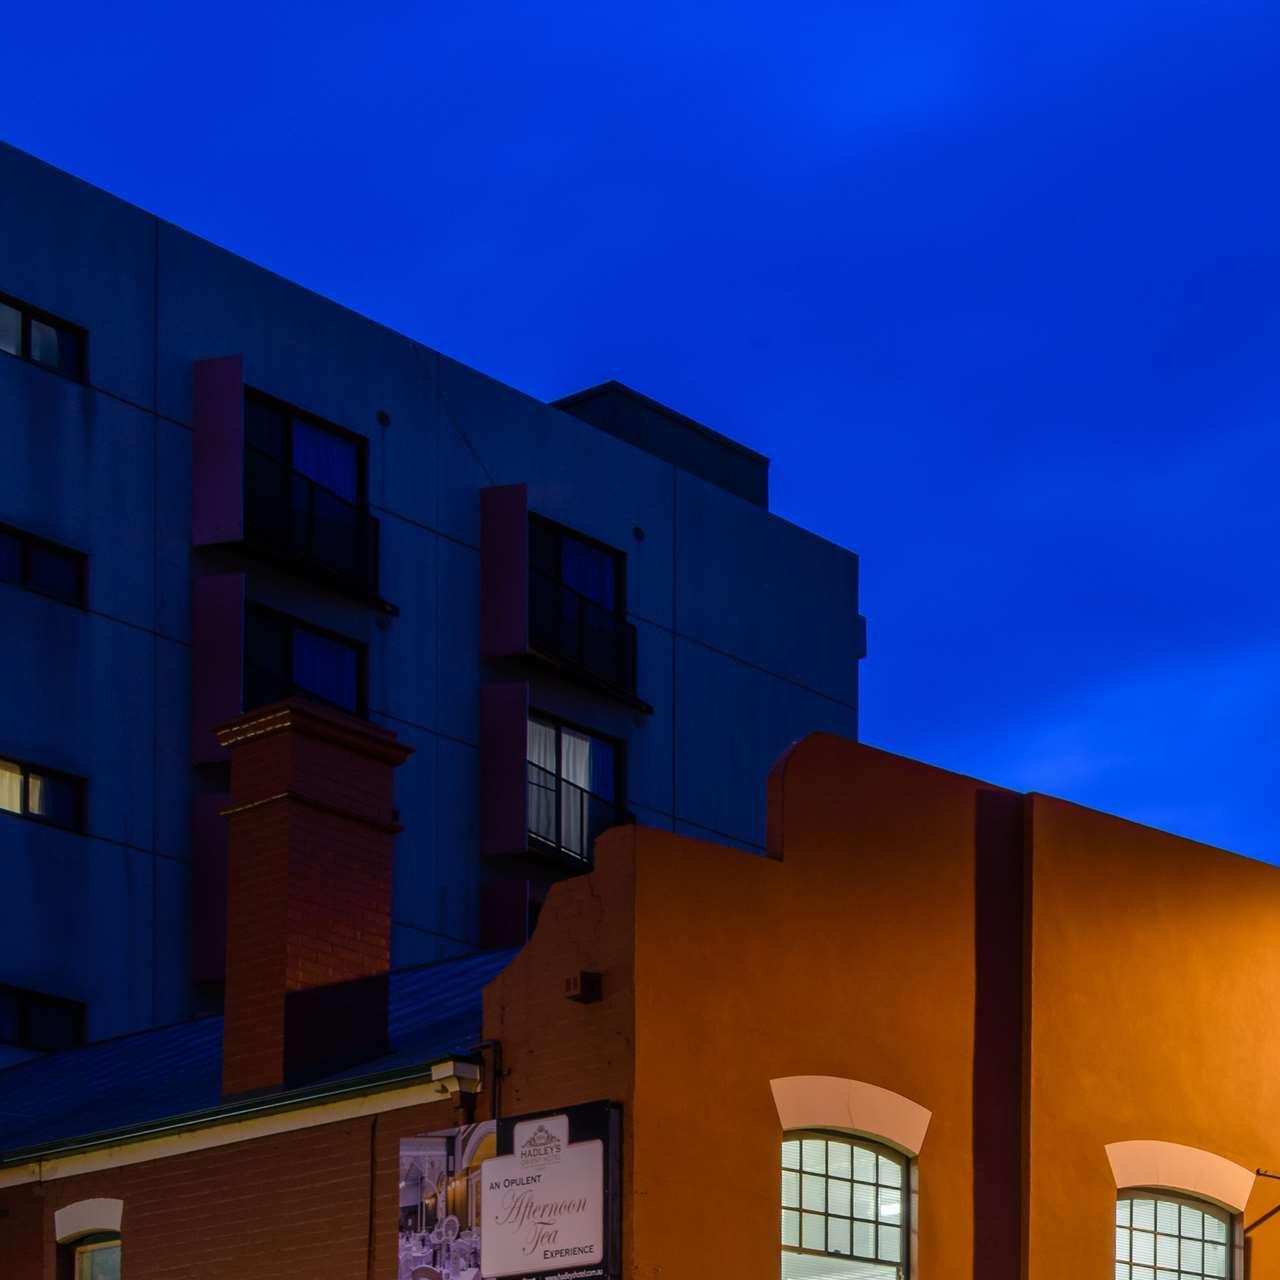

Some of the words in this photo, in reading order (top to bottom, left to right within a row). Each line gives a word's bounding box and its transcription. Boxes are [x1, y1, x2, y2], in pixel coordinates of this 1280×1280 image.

[489, 1181, 501, 1191] AN
[503, 1174, 542, 1189] OPULENT
[496, 1189, 588, 1232] Afternoon
[523, 1221, 560, 1256] Tea
[543, 1244, 595, 1260] EXPERIENCE
